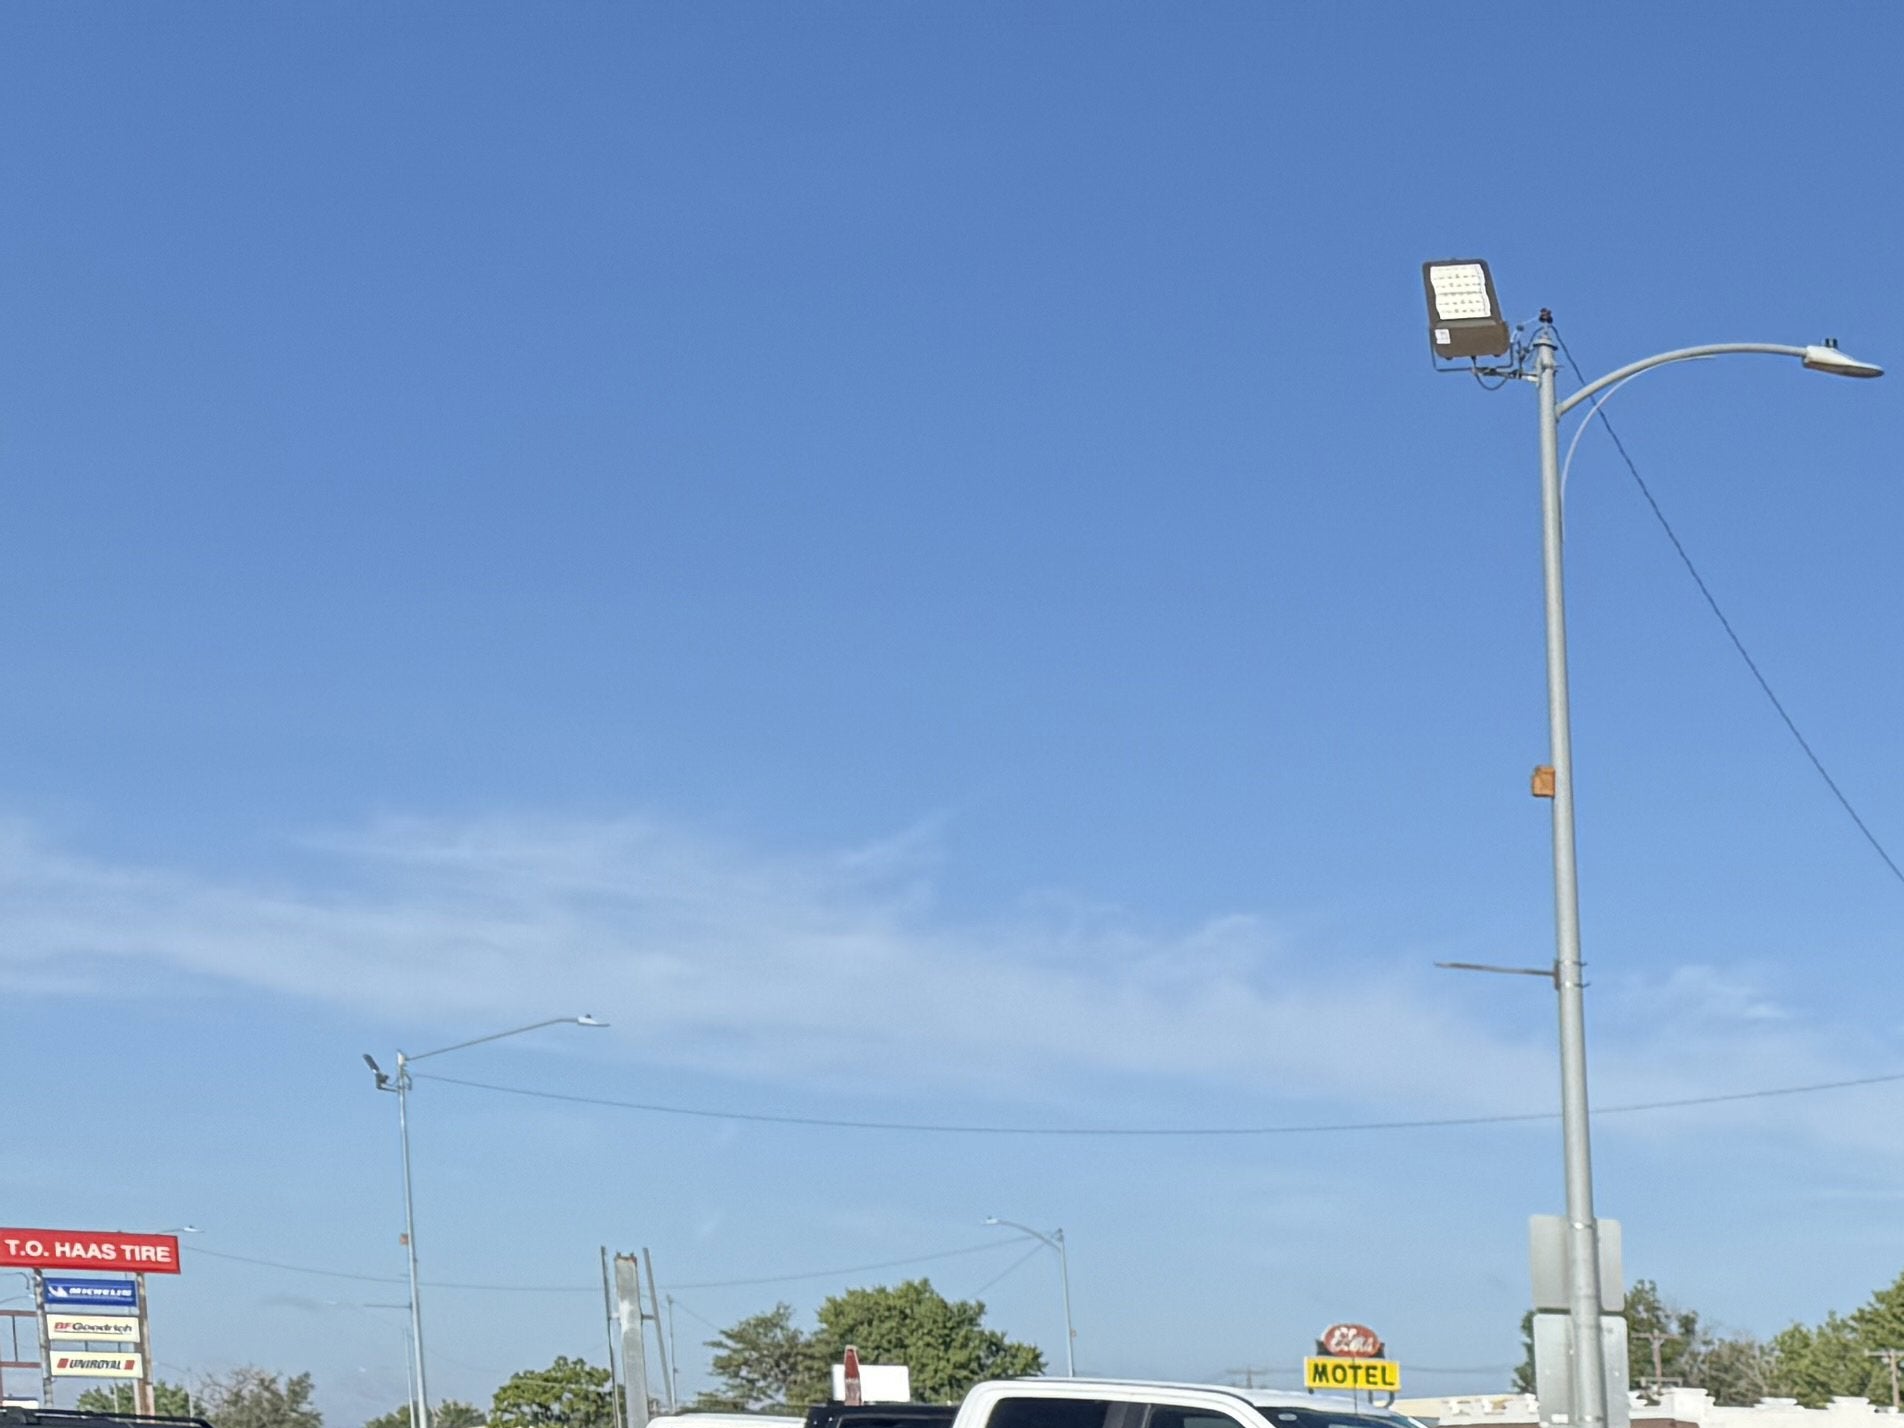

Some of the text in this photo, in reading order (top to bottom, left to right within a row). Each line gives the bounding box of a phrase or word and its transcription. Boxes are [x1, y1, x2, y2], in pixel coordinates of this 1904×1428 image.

[4, 1239, 172, 1263] T.O. HAAS TIRE
[69, 1359, 122, 1371] UNIROYAL
[1312, 1362, 1396, 1386] MOTEL
